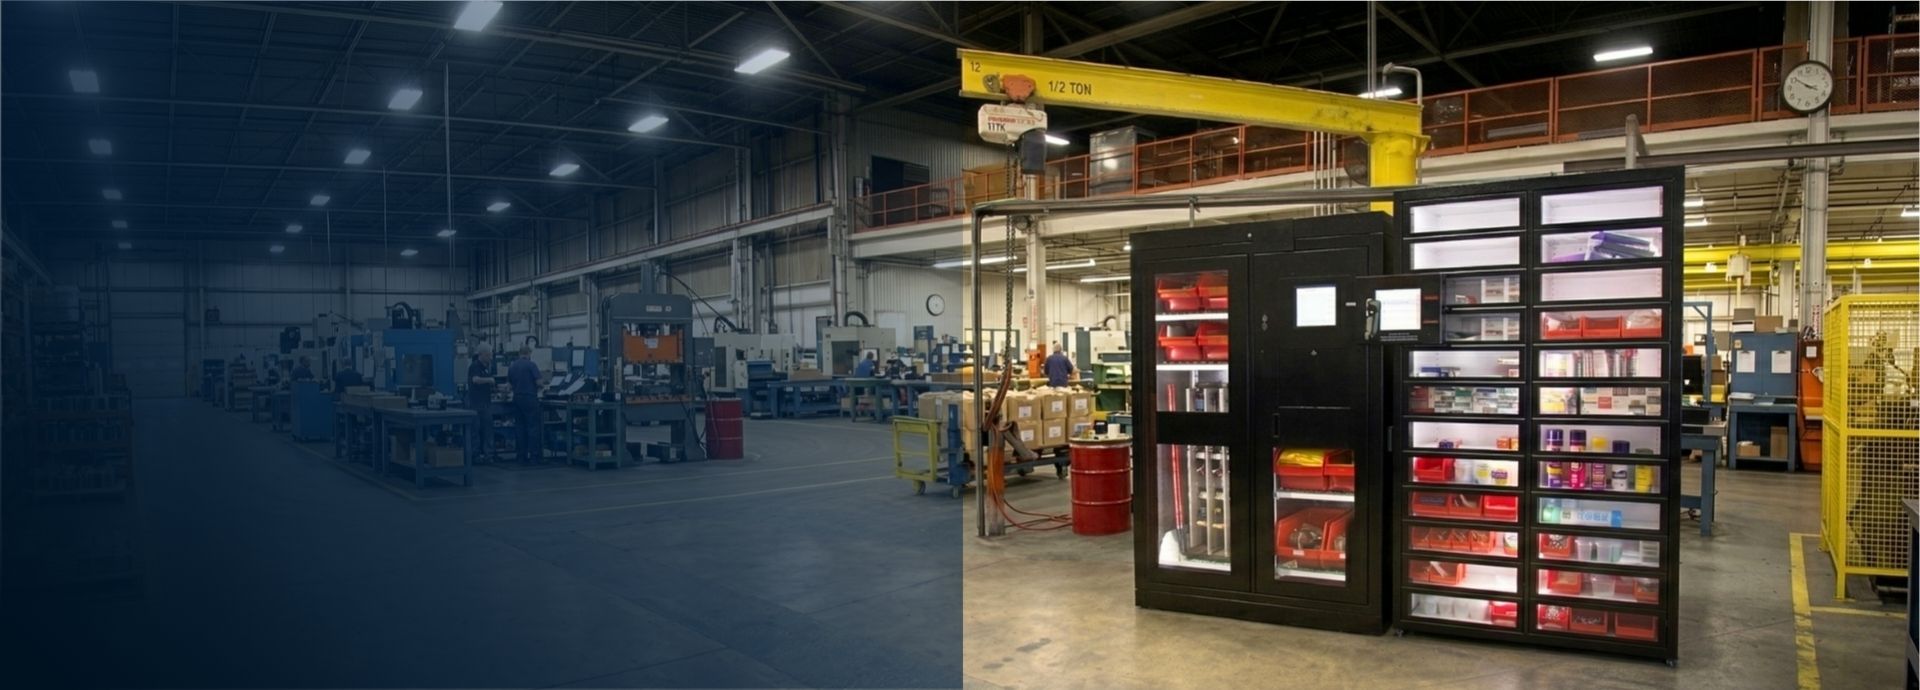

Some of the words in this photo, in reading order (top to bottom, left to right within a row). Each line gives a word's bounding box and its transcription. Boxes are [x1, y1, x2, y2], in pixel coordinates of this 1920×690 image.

[970, 61, 981, 73] 12
[1048, 81, 1066, 94] 1/2
[1070, 82, 1092, 96] TON
